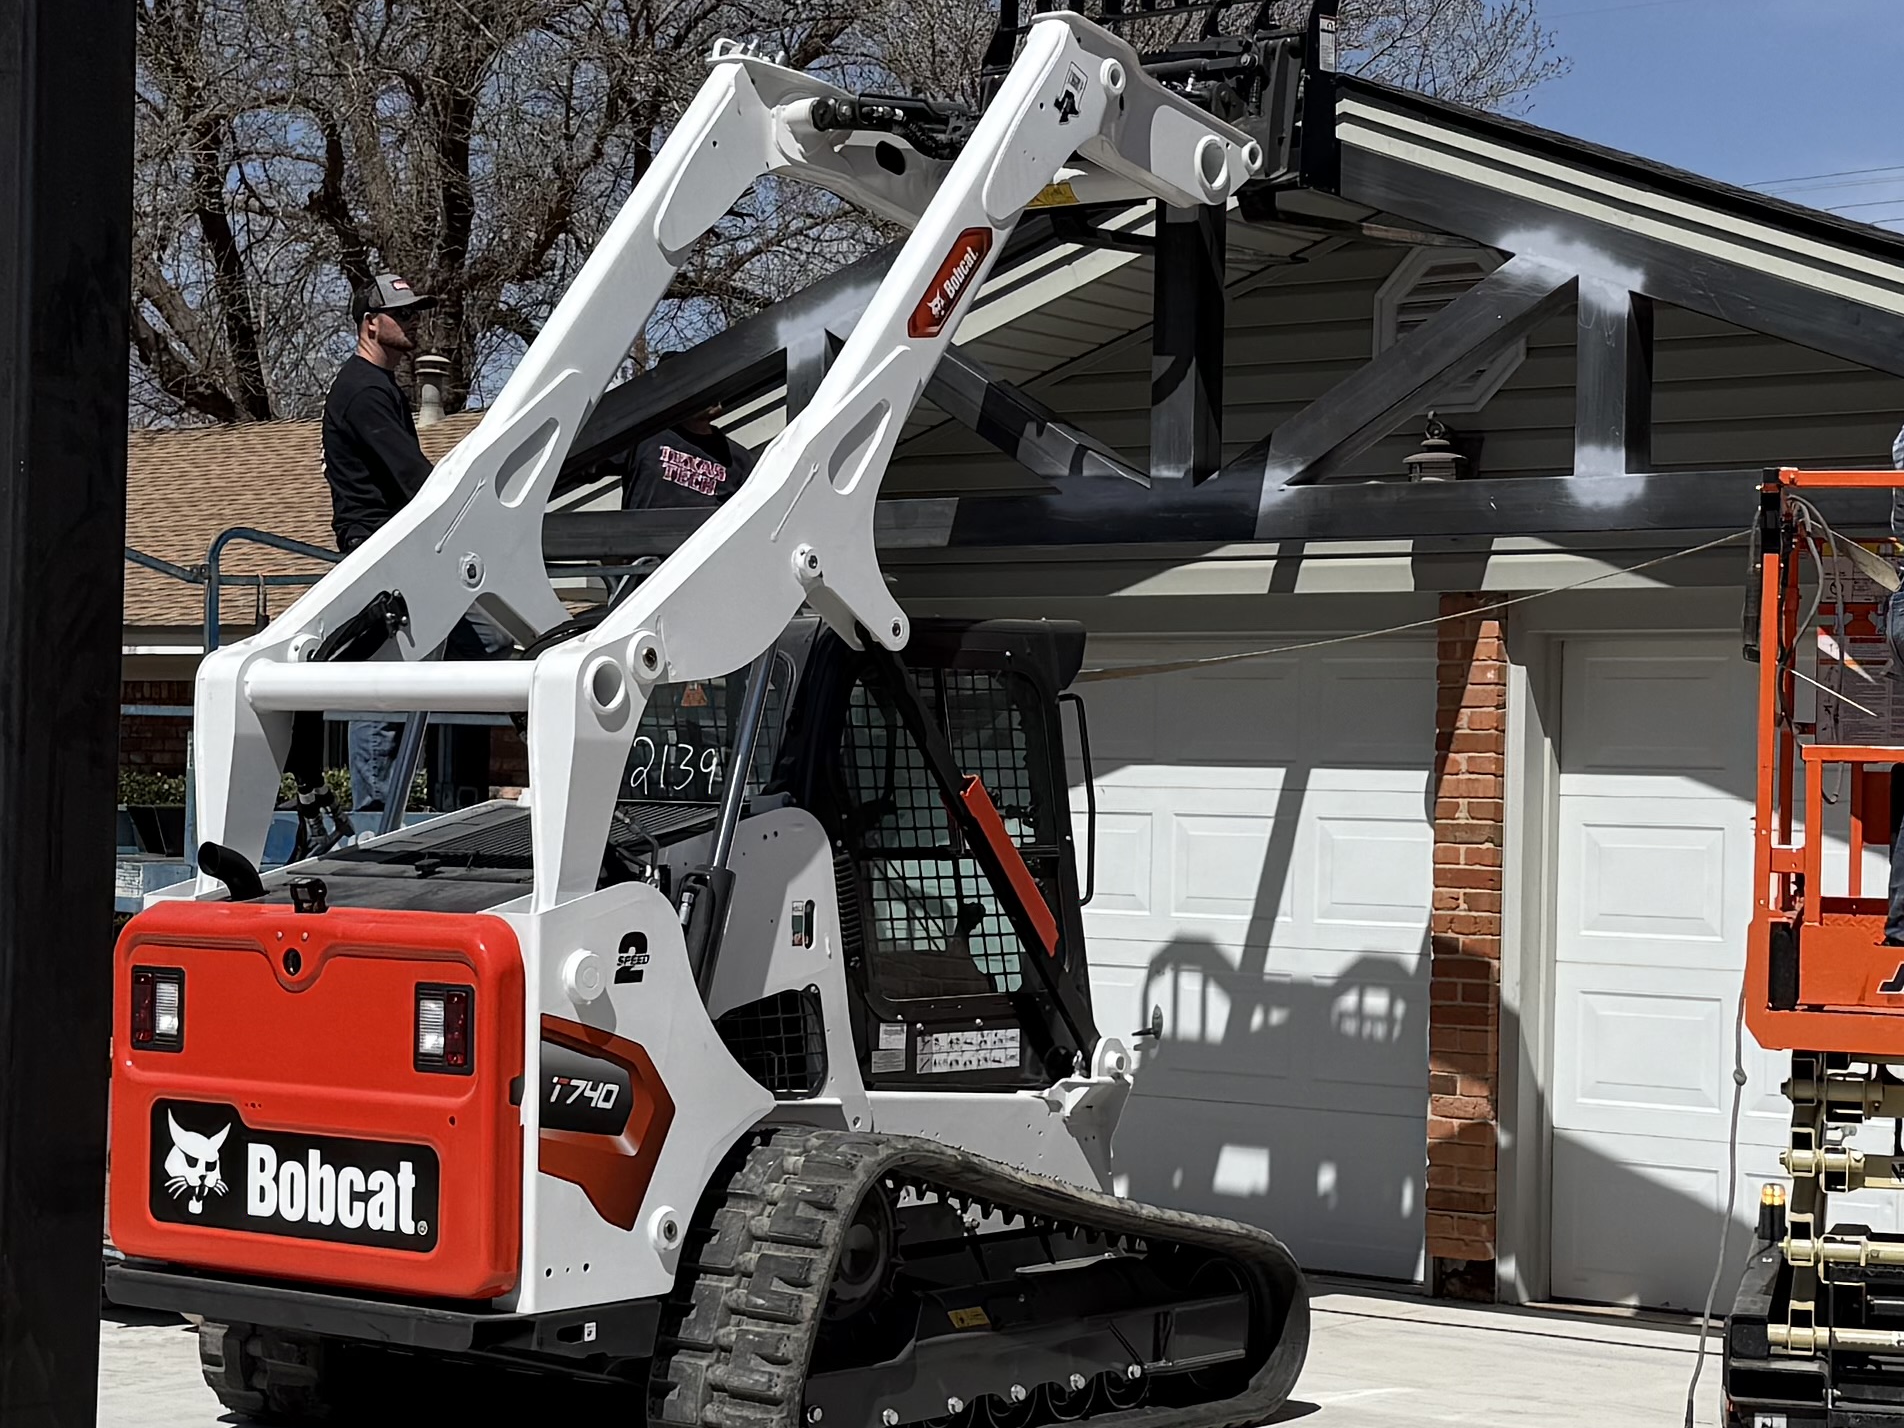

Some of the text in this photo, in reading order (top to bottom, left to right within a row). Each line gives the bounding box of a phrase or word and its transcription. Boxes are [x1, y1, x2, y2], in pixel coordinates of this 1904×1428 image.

[943, 246, 978, 299] Bobcat
[659, 446, 727, 481] TEXAS
[662, 462, 717, 495] TECH
[630, 736, 718, 794] 2139
[614, 931, 648, 984] 2
[616, 954, 650, 966] SPEED
[550, 1076, 620, 1109] T740
[247, 1142, 417, 1235] Bobcat
